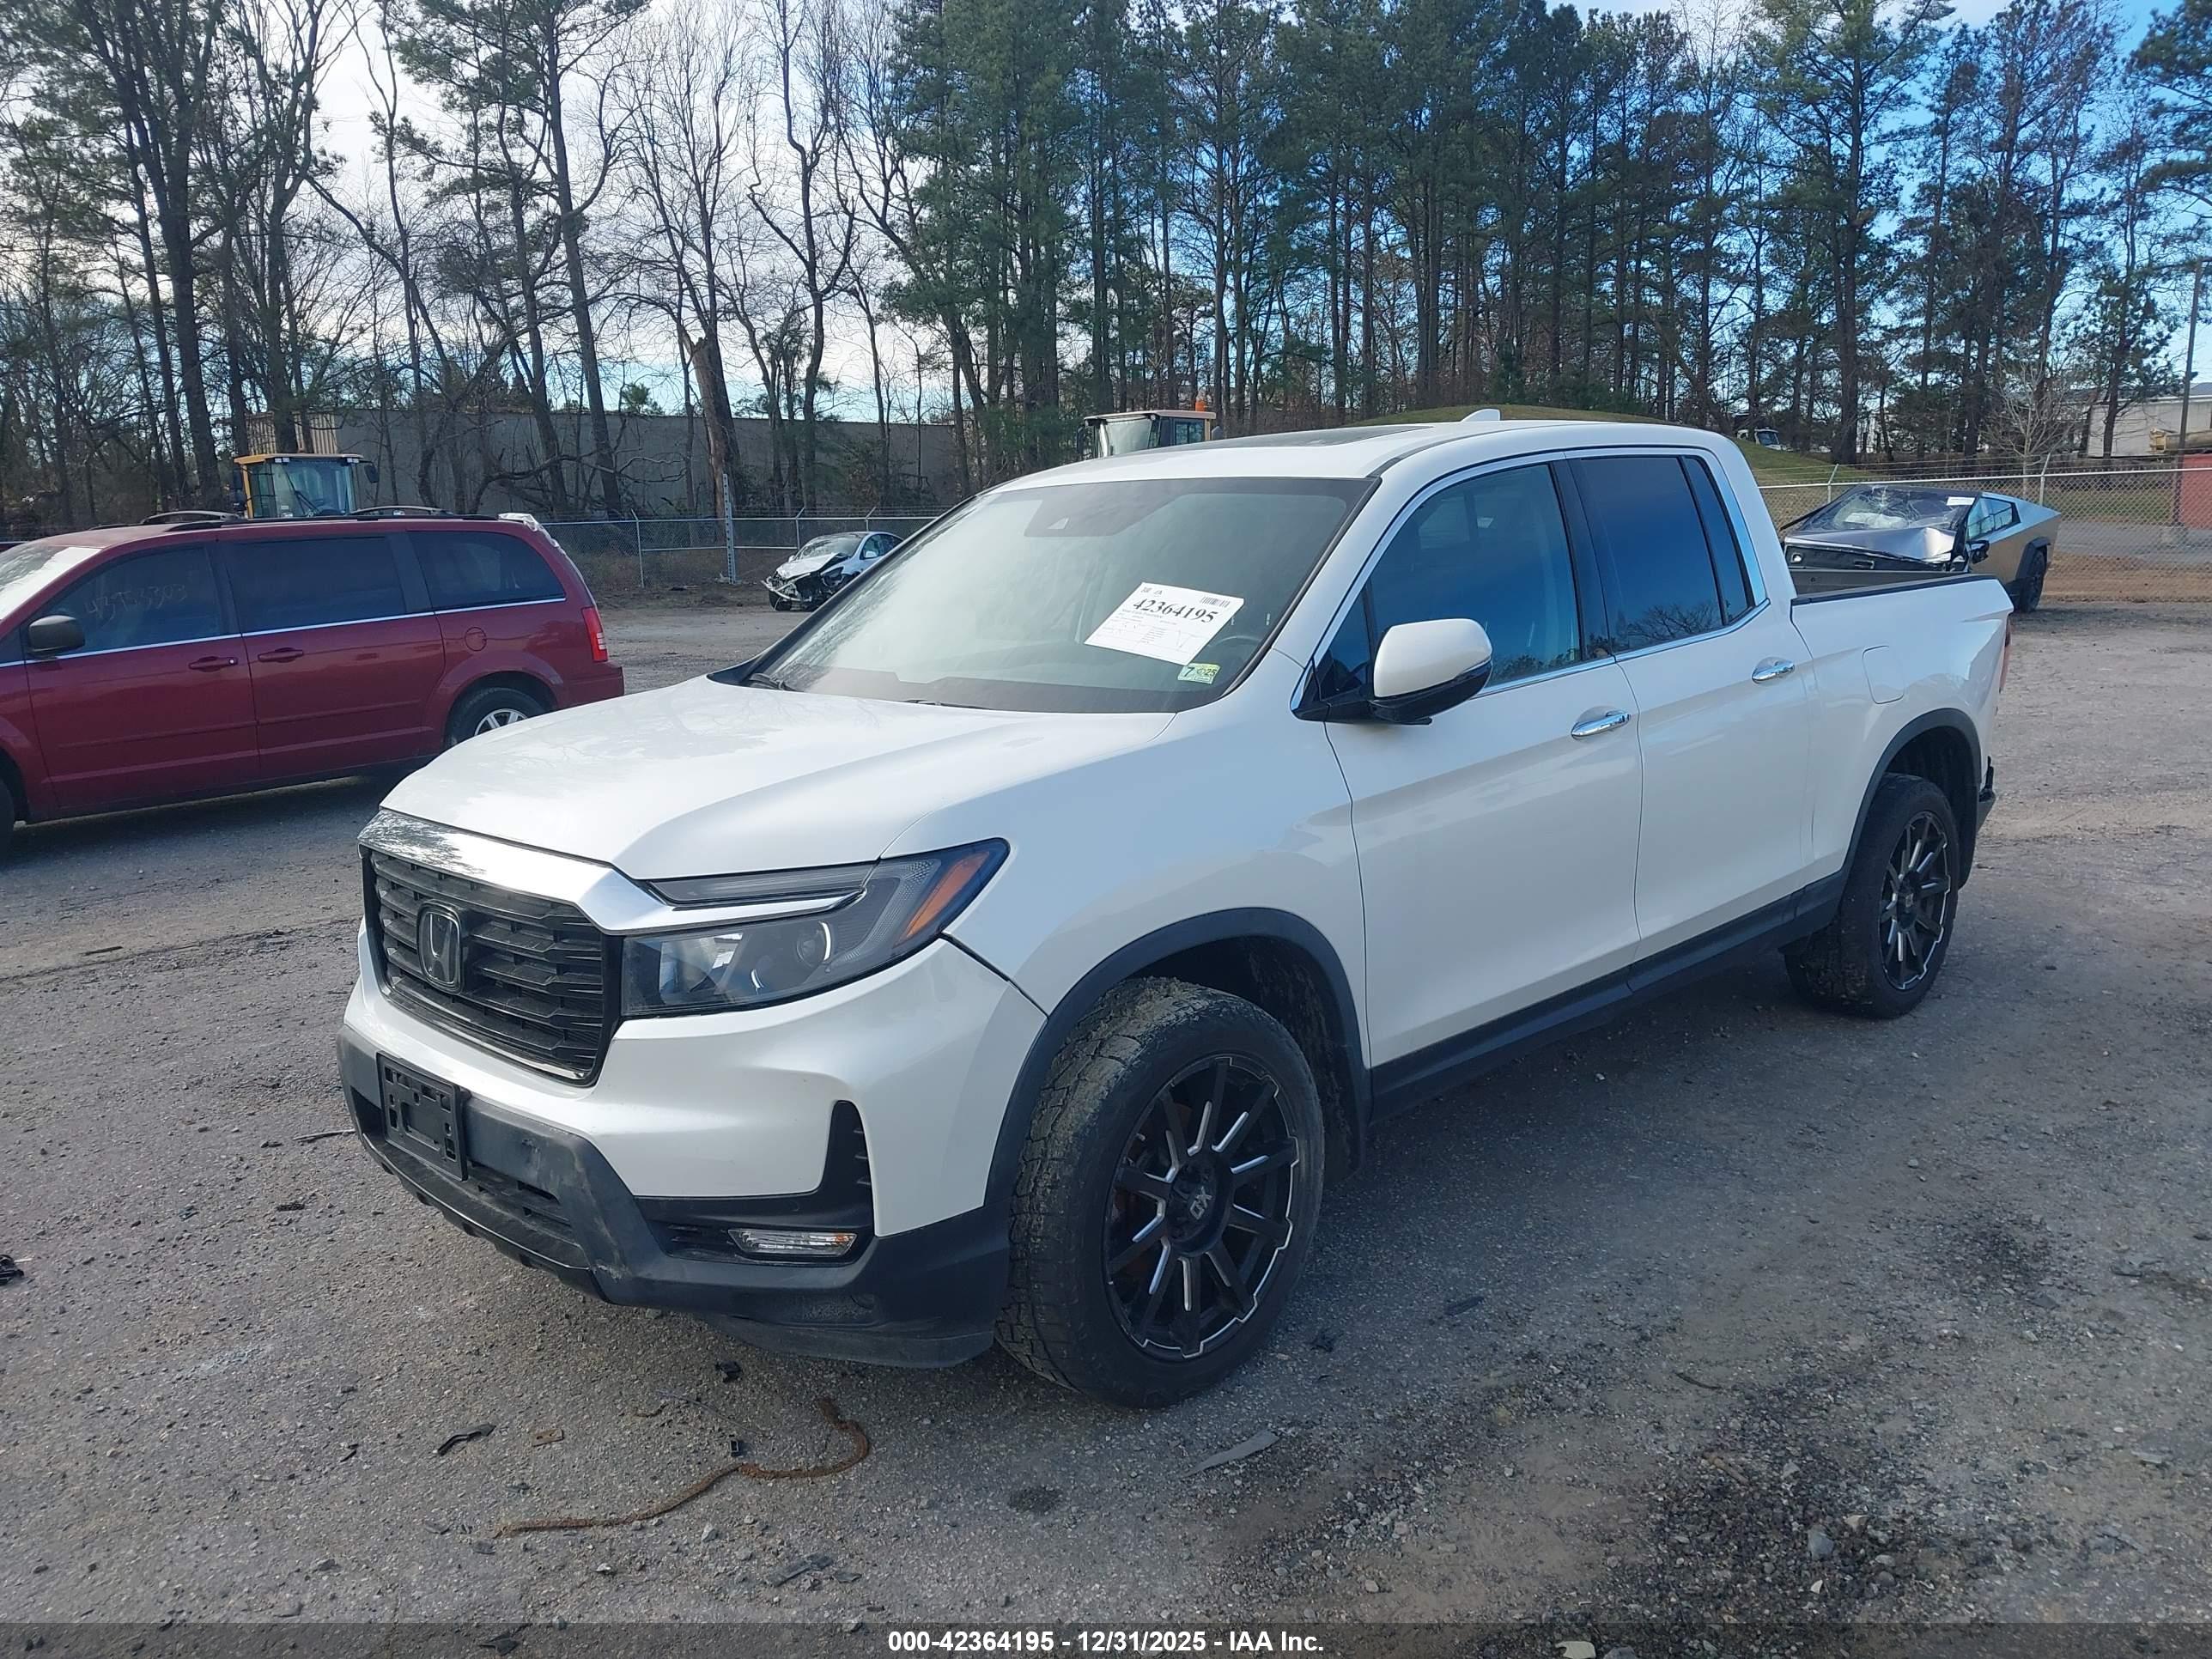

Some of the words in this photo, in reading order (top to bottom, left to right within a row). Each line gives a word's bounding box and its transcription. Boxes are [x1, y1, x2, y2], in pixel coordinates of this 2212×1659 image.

[1133, 599, 1218, 623] 42364195
[1184, 666, 1195, 677] 7
[1204, 668, 1218, 677] 25
